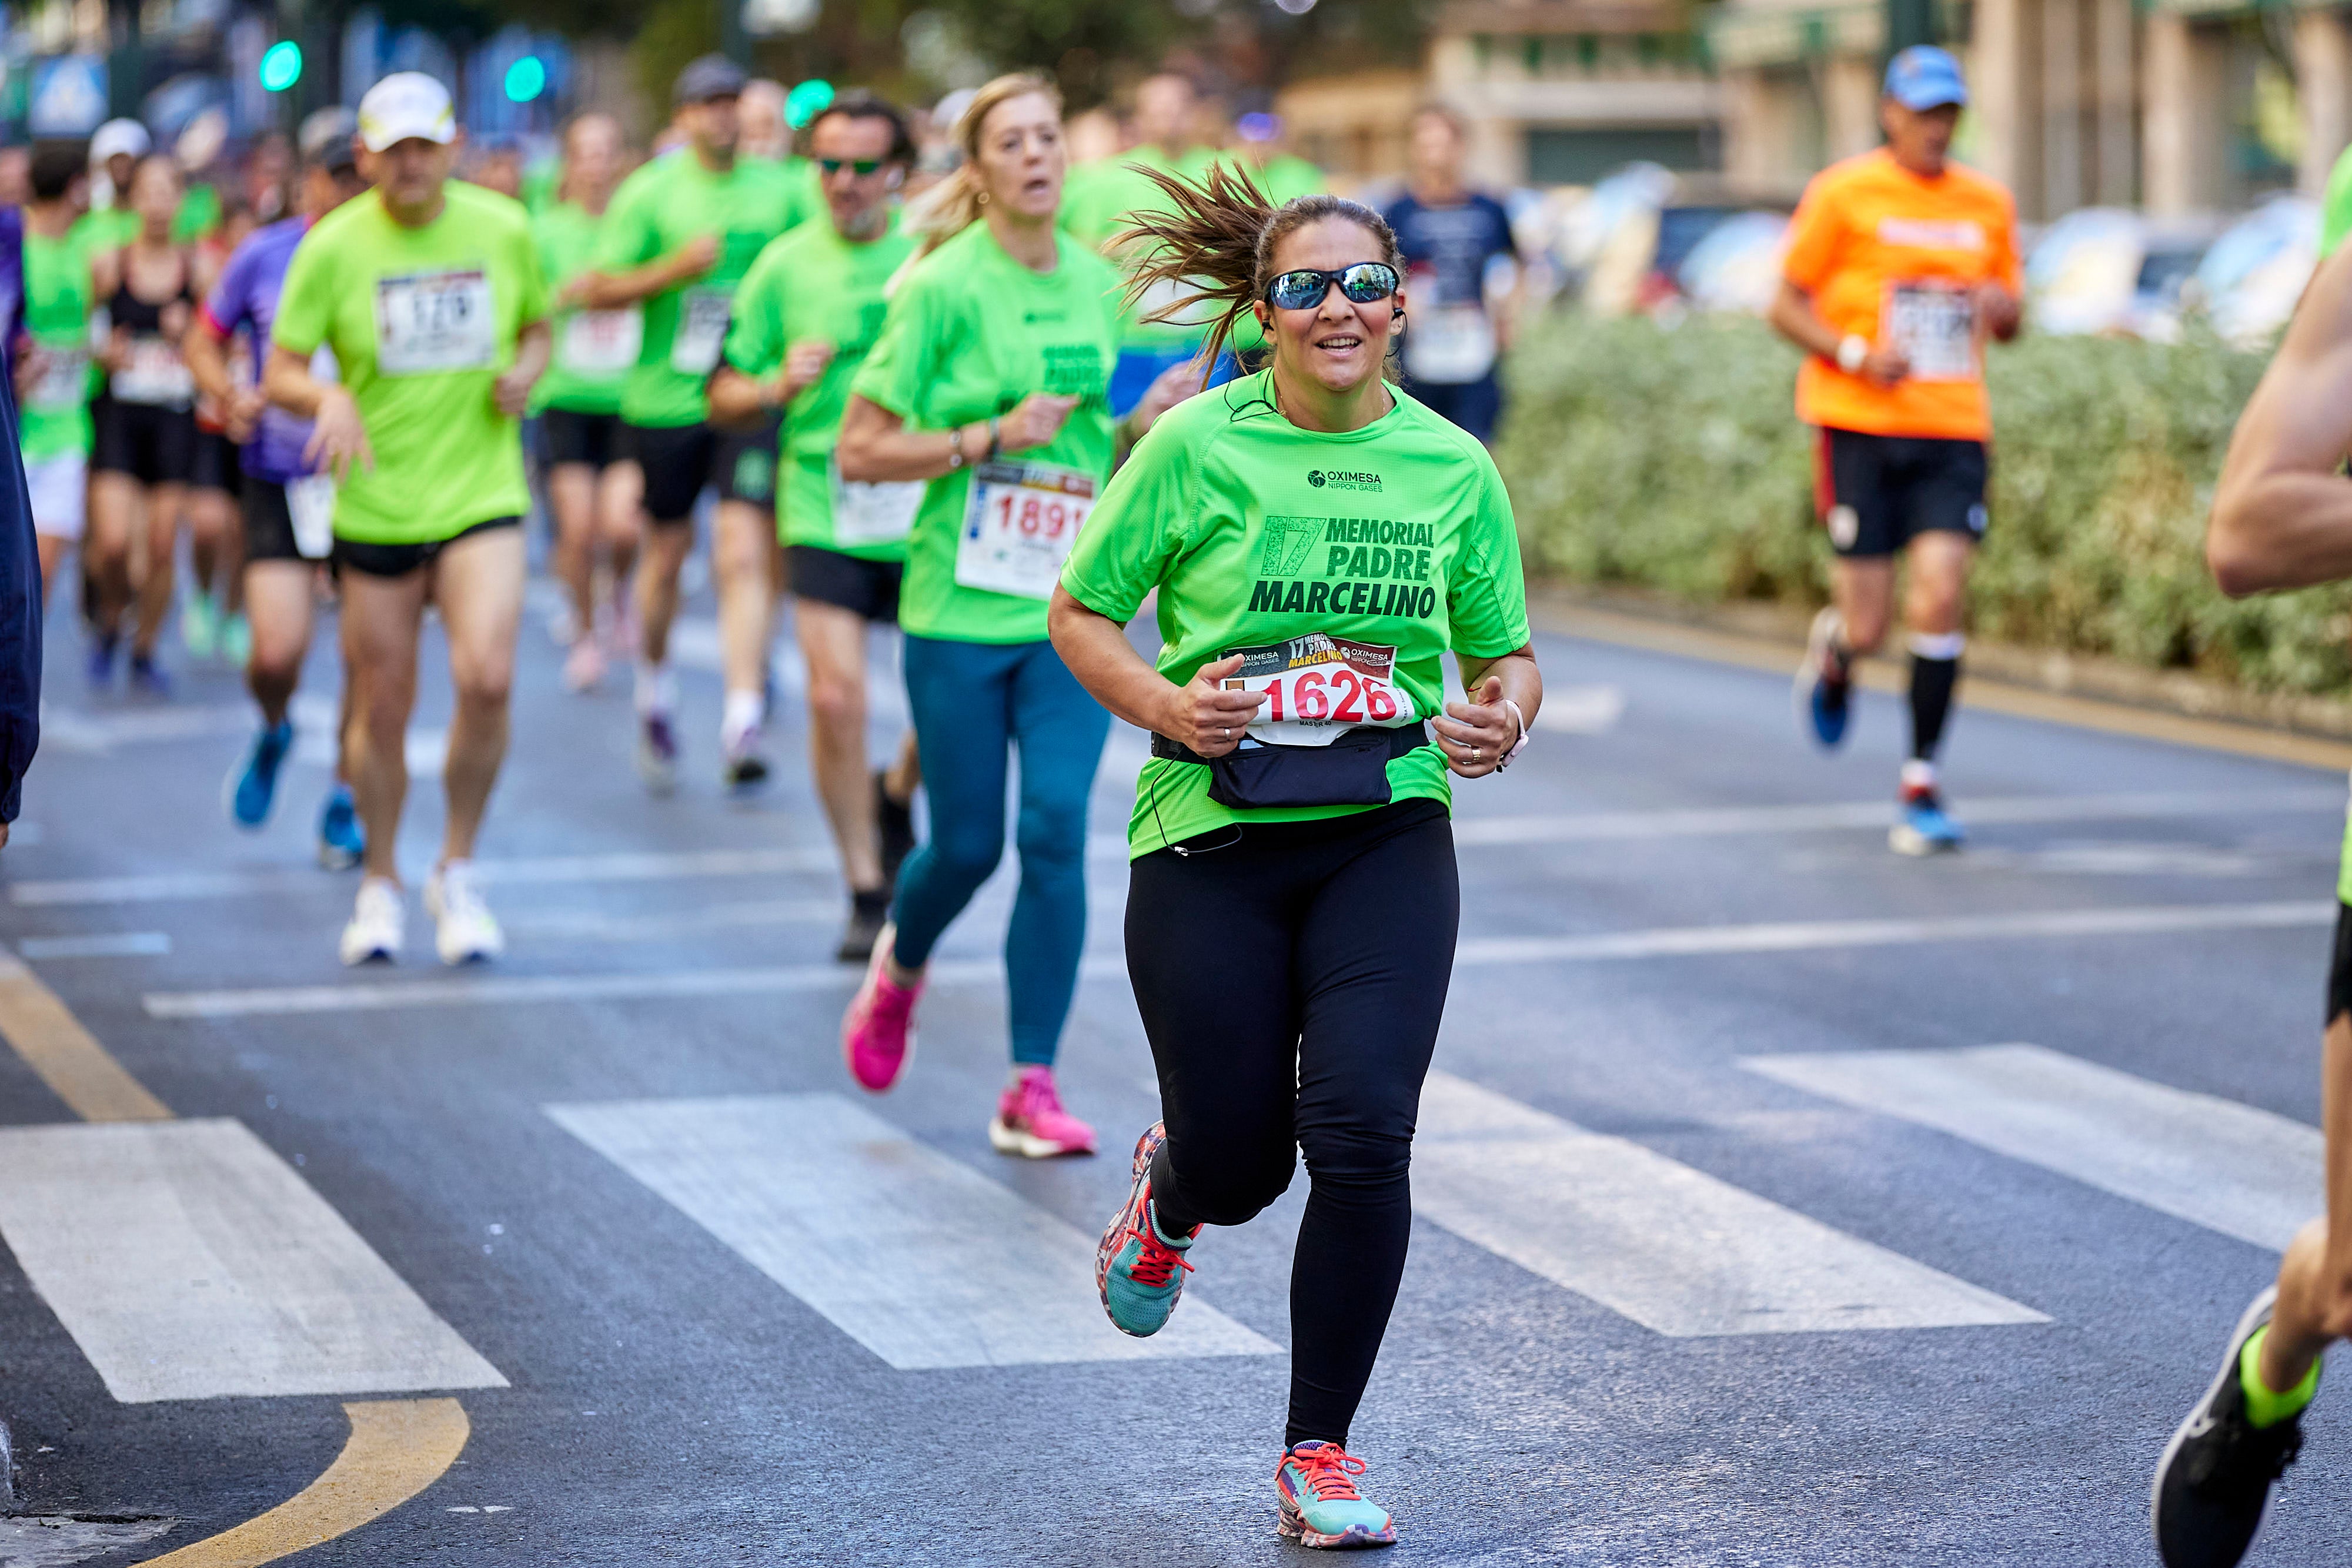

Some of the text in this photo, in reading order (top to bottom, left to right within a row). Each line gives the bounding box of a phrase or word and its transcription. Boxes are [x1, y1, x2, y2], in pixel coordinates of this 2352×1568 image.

[1327, 471, 1382, 484] OXIMESA
[1358, 484, 1382, 493] GASES
[1324, 517, 1435, 549] MEMORIAL
[1261, 515, 1327, 577] 17
[1325, 545, 1431, 581] PADRE
[1247, 580, 1436, 619] MARCELINO
[1244, 651, 1279, 662] XIMESA
[1288, 637, 1305, 659] 17
[1288, 650, 1343, 668] MARCELINO
[1351, 648, 1388, 661] OXIMESA
[1262, 670, 1397, 723] 1626
